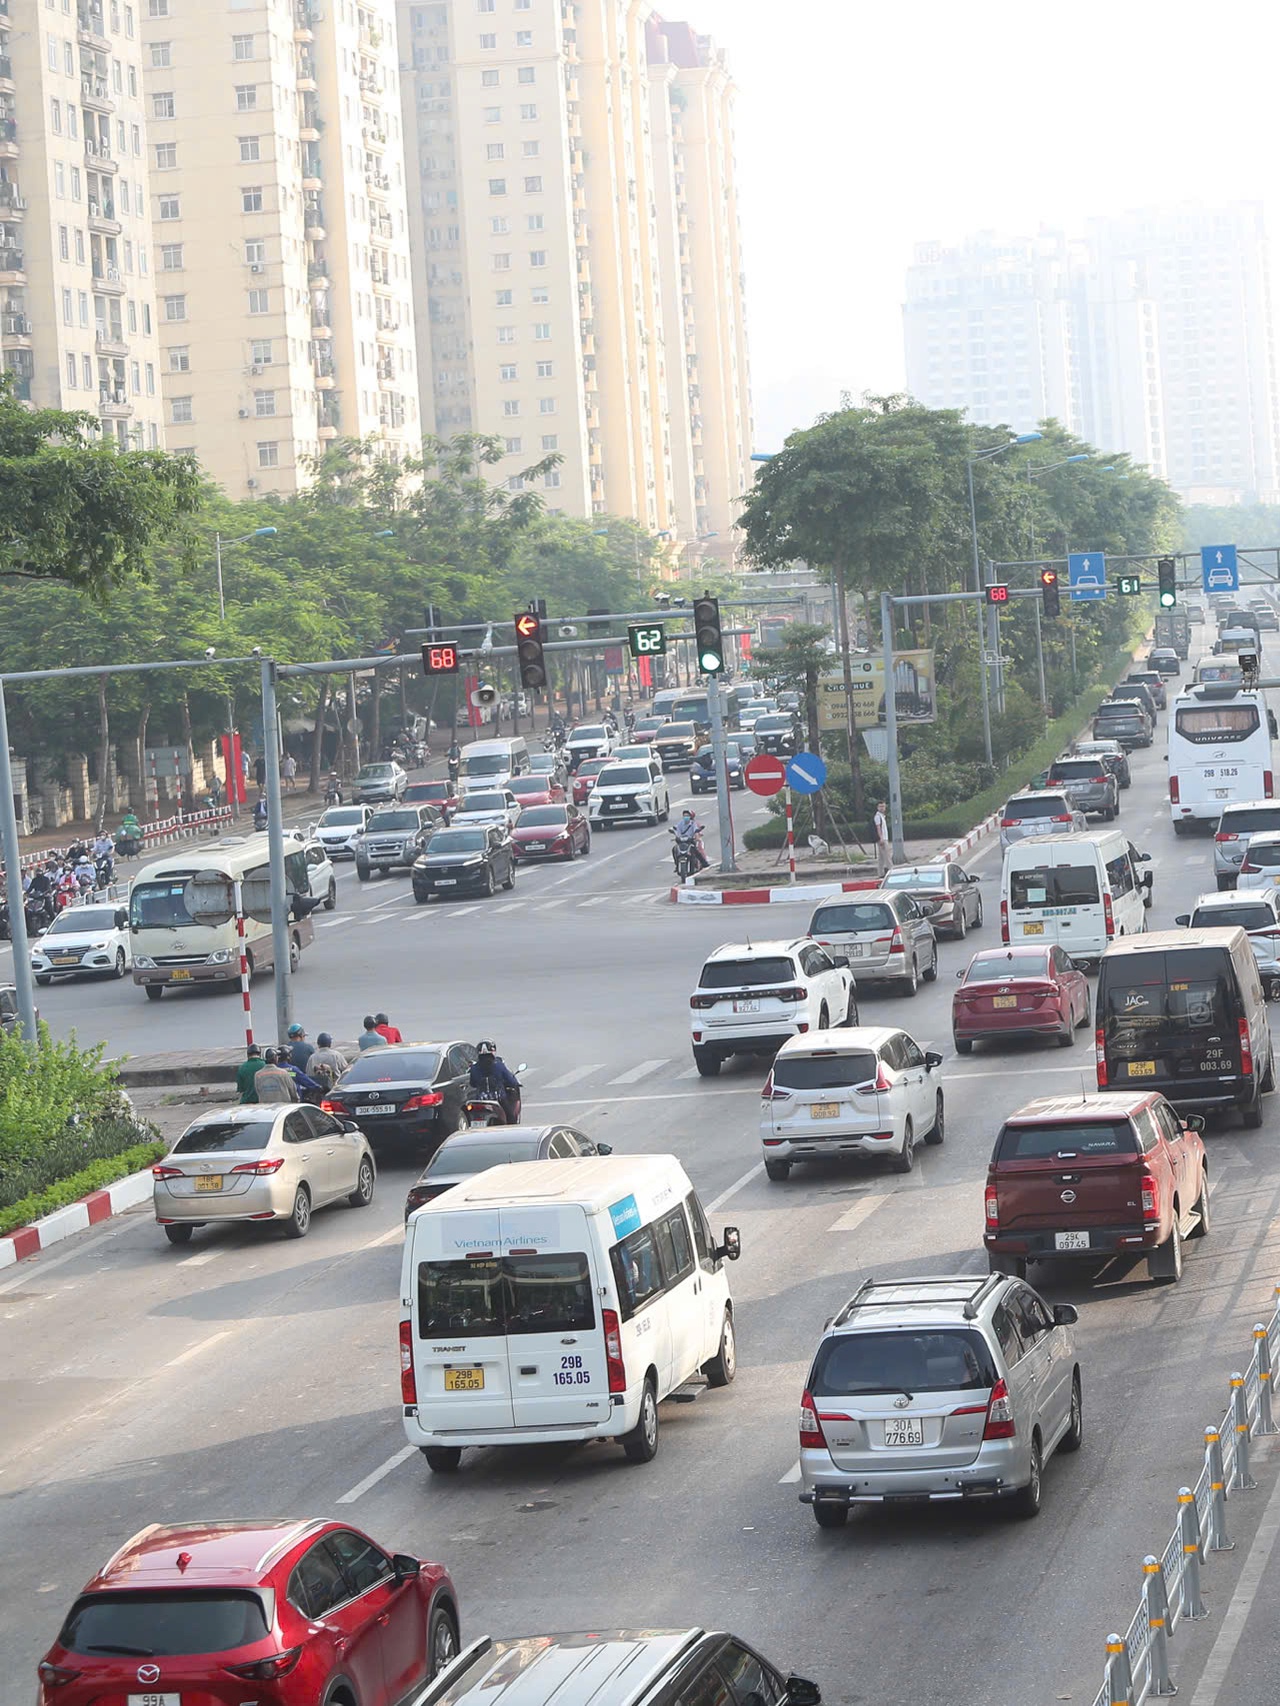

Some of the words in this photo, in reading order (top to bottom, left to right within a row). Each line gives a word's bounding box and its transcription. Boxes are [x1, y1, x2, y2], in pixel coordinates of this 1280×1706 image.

[1121, 579, 1138, 593] 61
[990, 588, 1007, 601] 68
[637, 630, 661, 651] 62
[431, 648, 454, 668] 68
[1125, 995, 1145, 1006] JAC
[1206, 1049, 1224, 1059] 29F
[1200, 1061, 1232, 1071] 003.69
[454, 1238, 501, 1249] Vietnam
[503, 1235, 548, 1247] Airlines
[561, 1356, 583, 1369] 29B
[455, 1370, 473, 1379] 29B
[553, 1371, 590, 1385] 165.05
[450, 1379, 480, 1389] 165.05
[893, 1419, 914, 1432] 30A
[886, 1432, 921, 1445] 776.69
